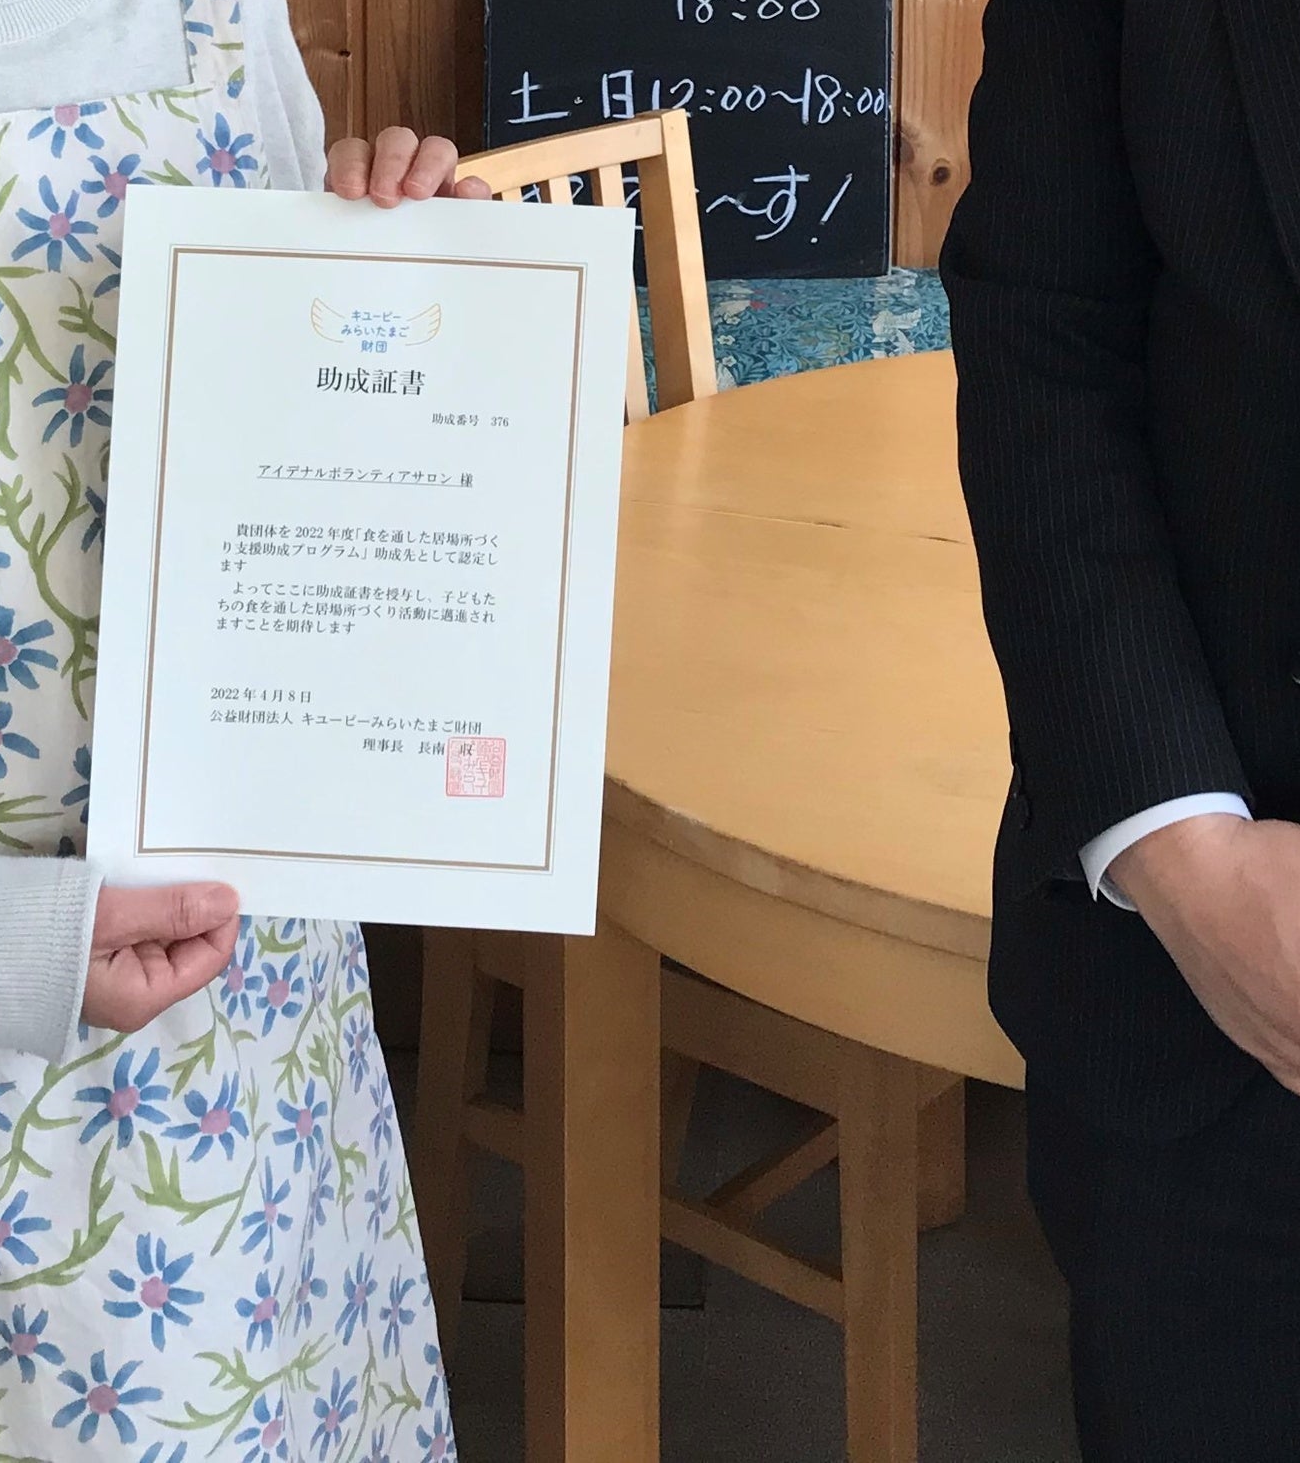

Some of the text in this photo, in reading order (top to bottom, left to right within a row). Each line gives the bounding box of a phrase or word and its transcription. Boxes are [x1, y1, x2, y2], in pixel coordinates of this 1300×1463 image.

[340, 324, 410, 338] みらいたまご
[360, 340, 388, 353] 財団
[316, 366, 426, 396] 助成証書
[431, 412, 510, 428] 助成番号 376
[460, 472, 473, 488] 様
[220, 559, 247, 572] ます
[216, 617, 356, 634] ますことを期待します
[210, 709, 293, 725] 公益財団法人
[362, 738, 404, 754] 理事長
[418, 741, 445, 756] 長南
